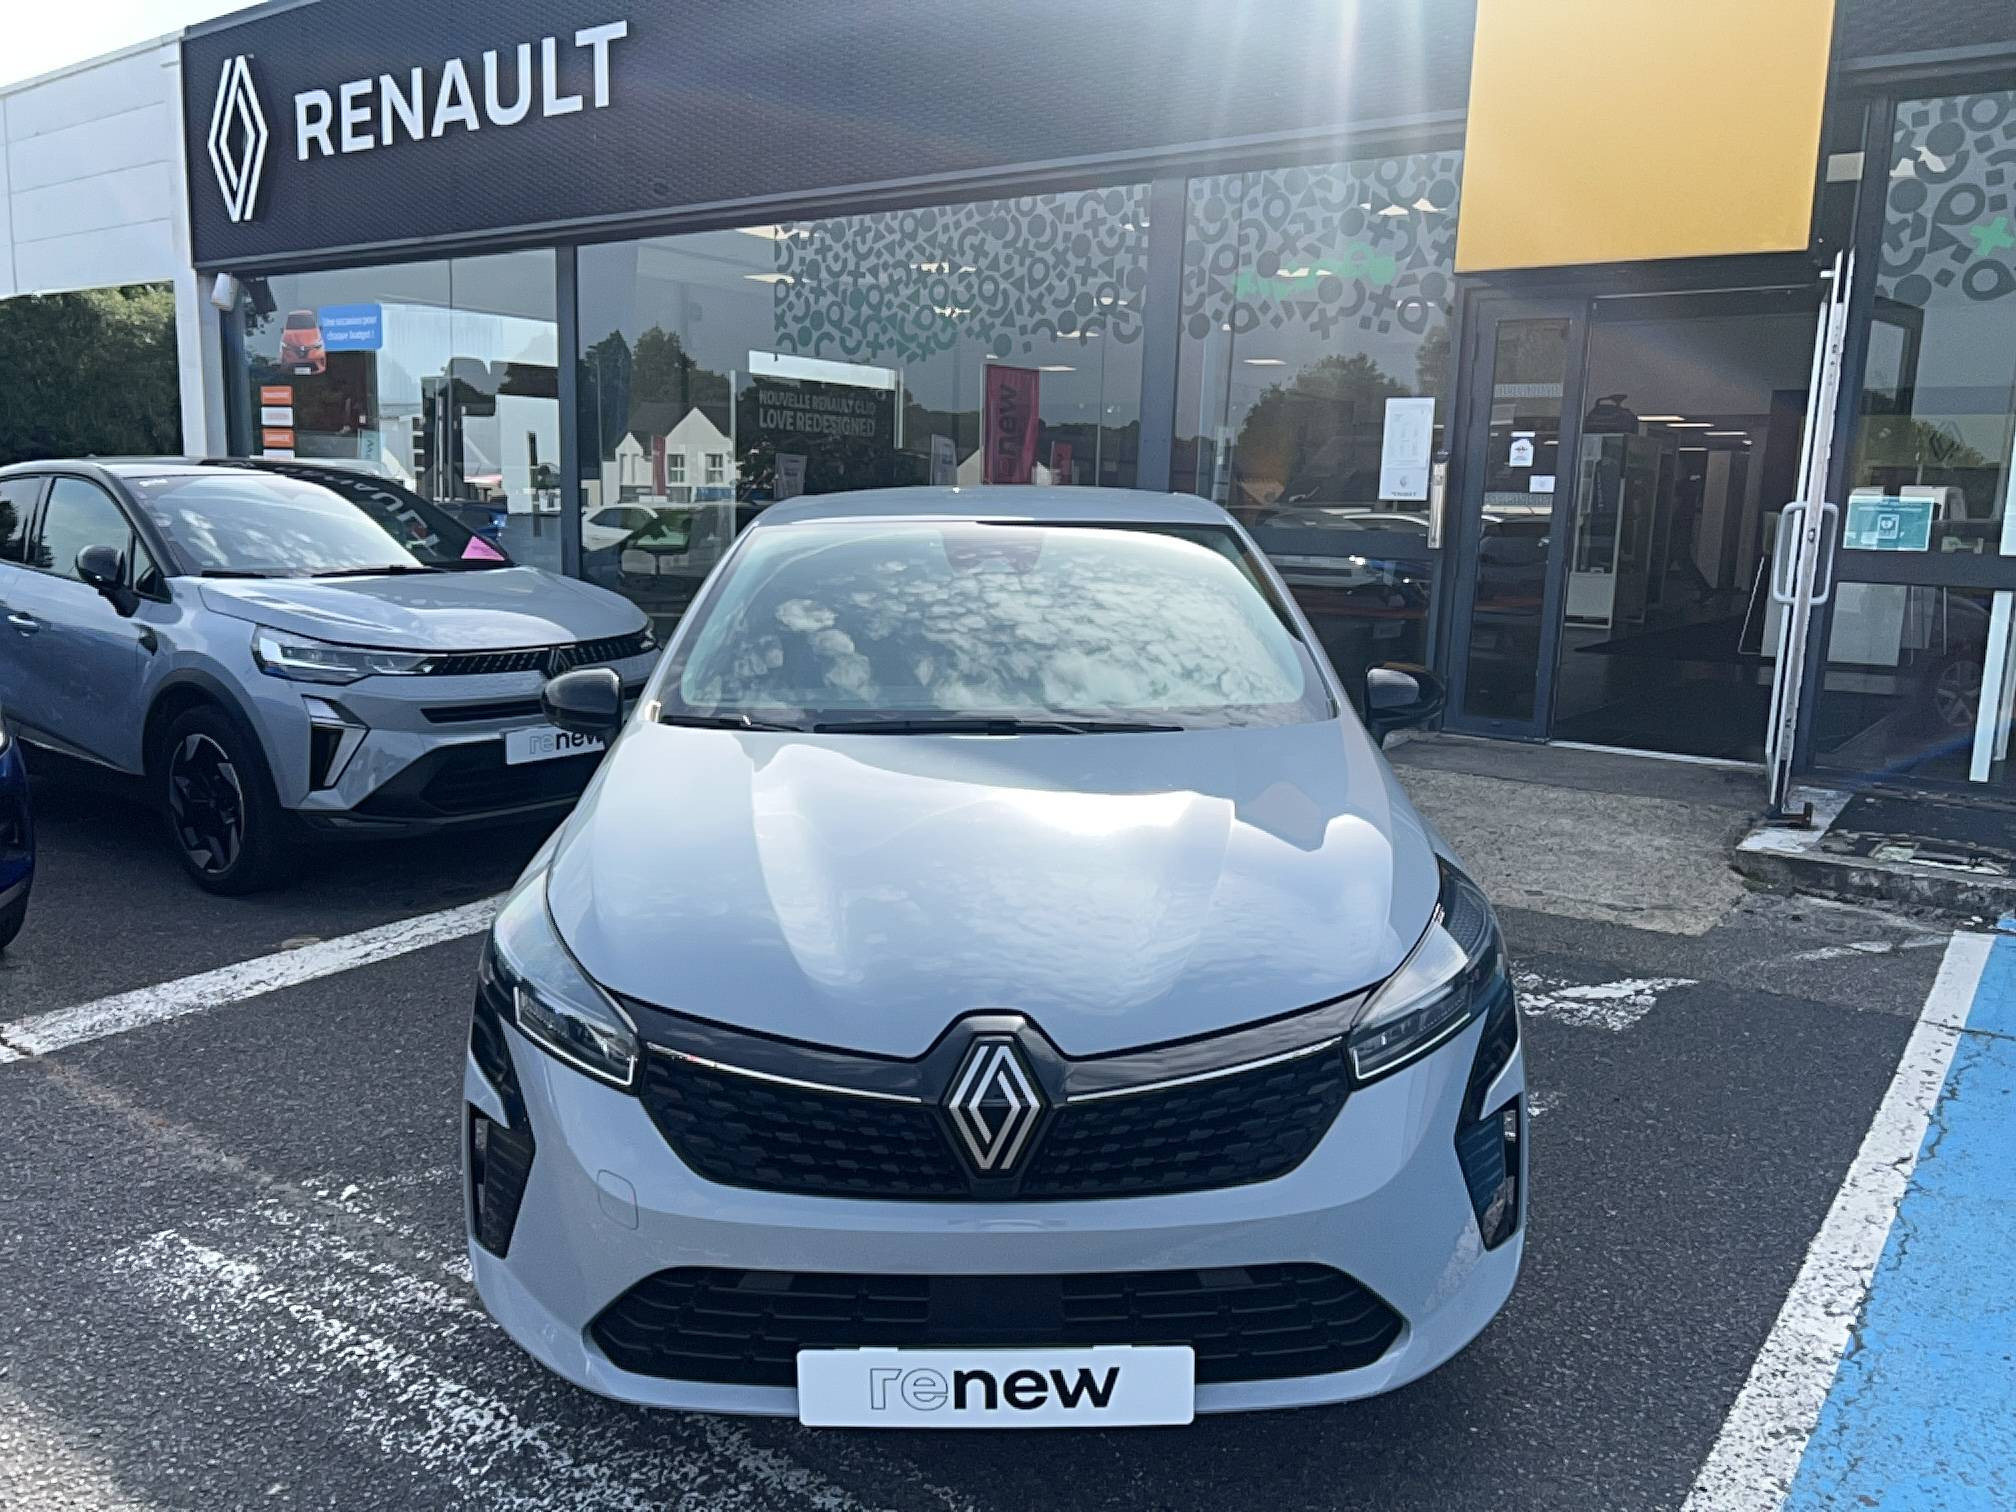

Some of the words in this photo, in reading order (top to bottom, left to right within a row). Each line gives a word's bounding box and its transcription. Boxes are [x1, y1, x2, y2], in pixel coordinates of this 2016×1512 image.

[295, 20, 627, 161] RENAULT
[759, 408, 794, 431] LOVE
[796, 412, 876, 438] REDESIGNED
[870, 1366, 1120, 1411] renew
